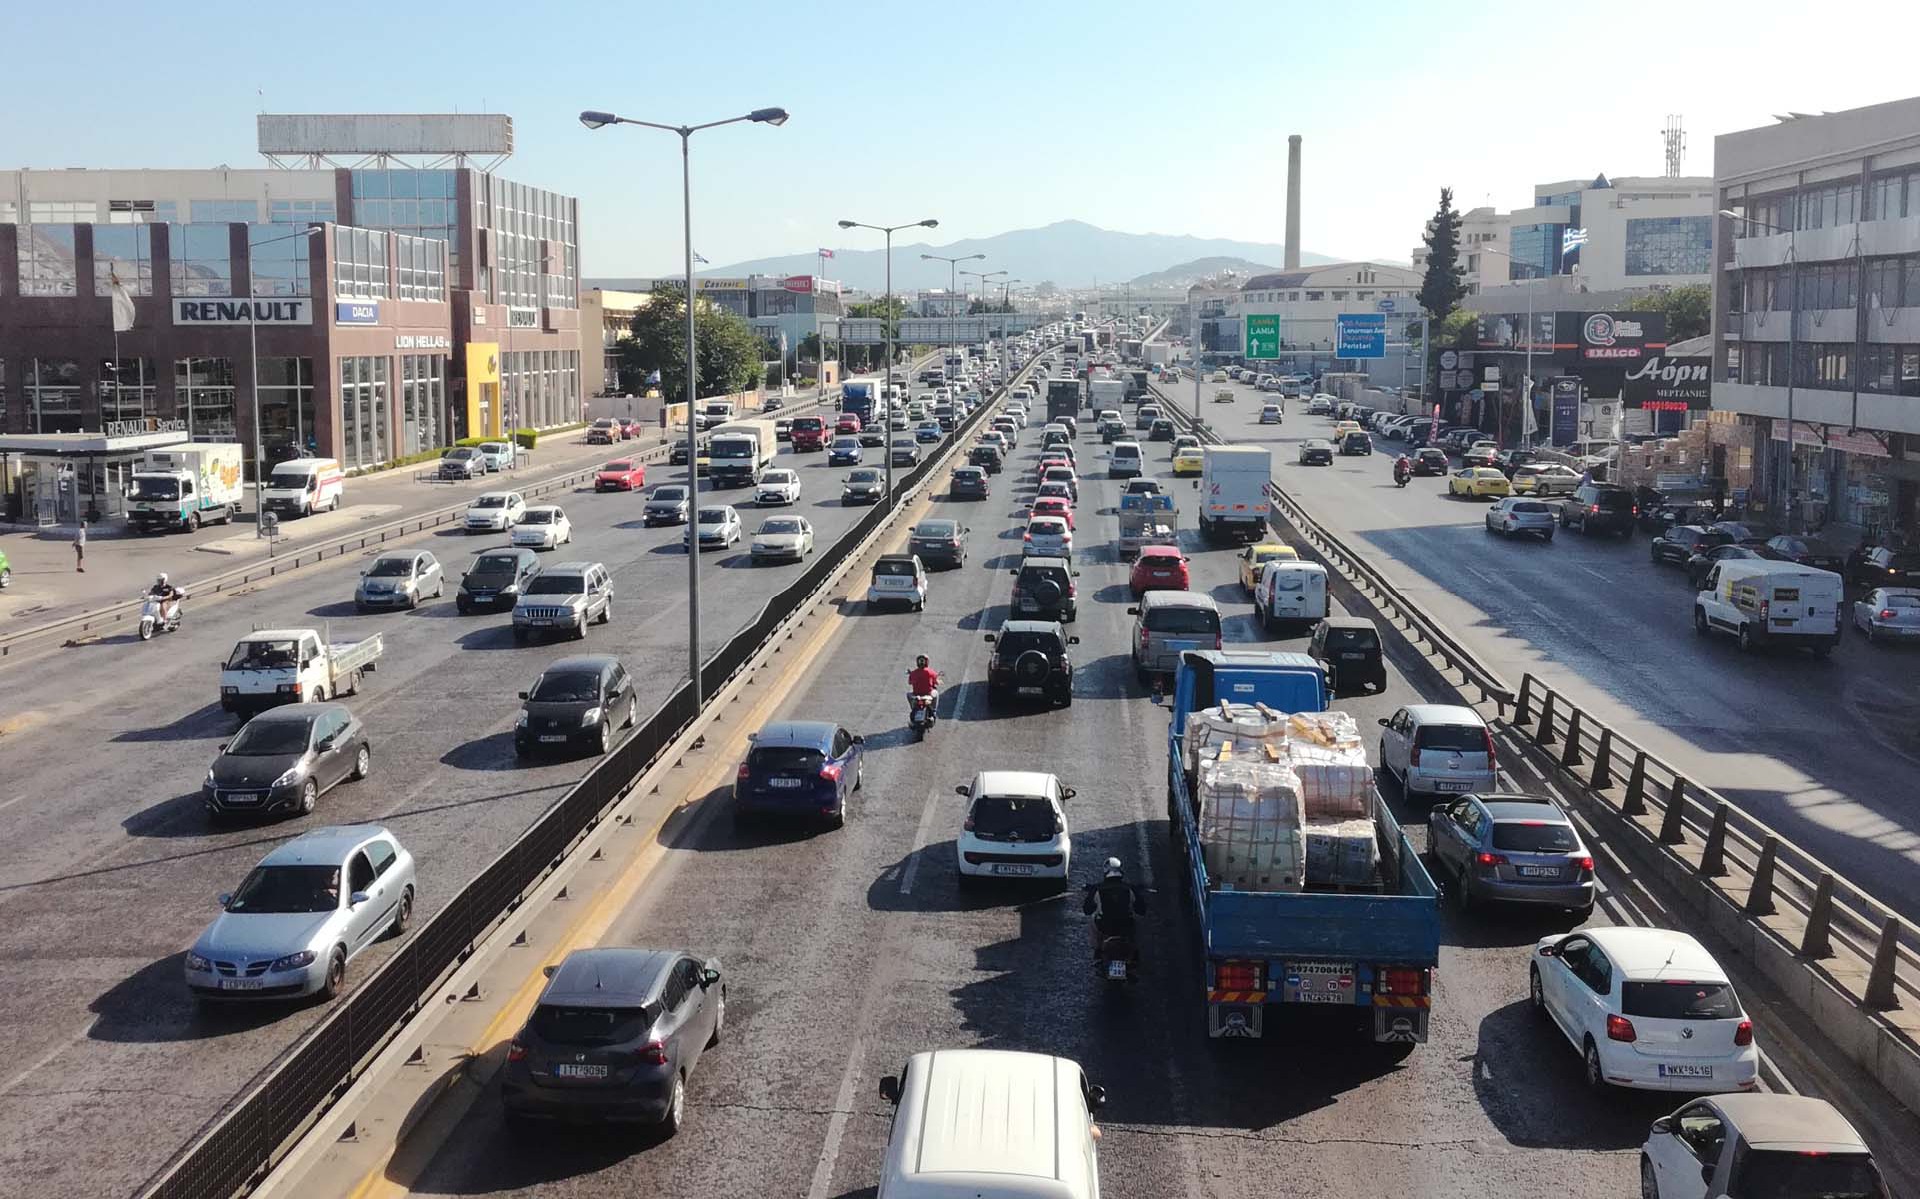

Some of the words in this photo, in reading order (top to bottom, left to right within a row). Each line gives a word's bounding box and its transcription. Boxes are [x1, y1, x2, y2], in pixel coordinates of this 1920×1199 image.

[179, 301, 302, 321] RENAULT
[352, 306, 374, 317] DACIA
[1250, 327, 1275, 335] LAMIA
[395, 336, 414, 349] LION
[416, 335, 444, 348] HELLAS
[1587, 348, 1638, 358] EXALCO
[107, 420, 149, 437] RENAULT
[156, 418, 186, 433] Service
